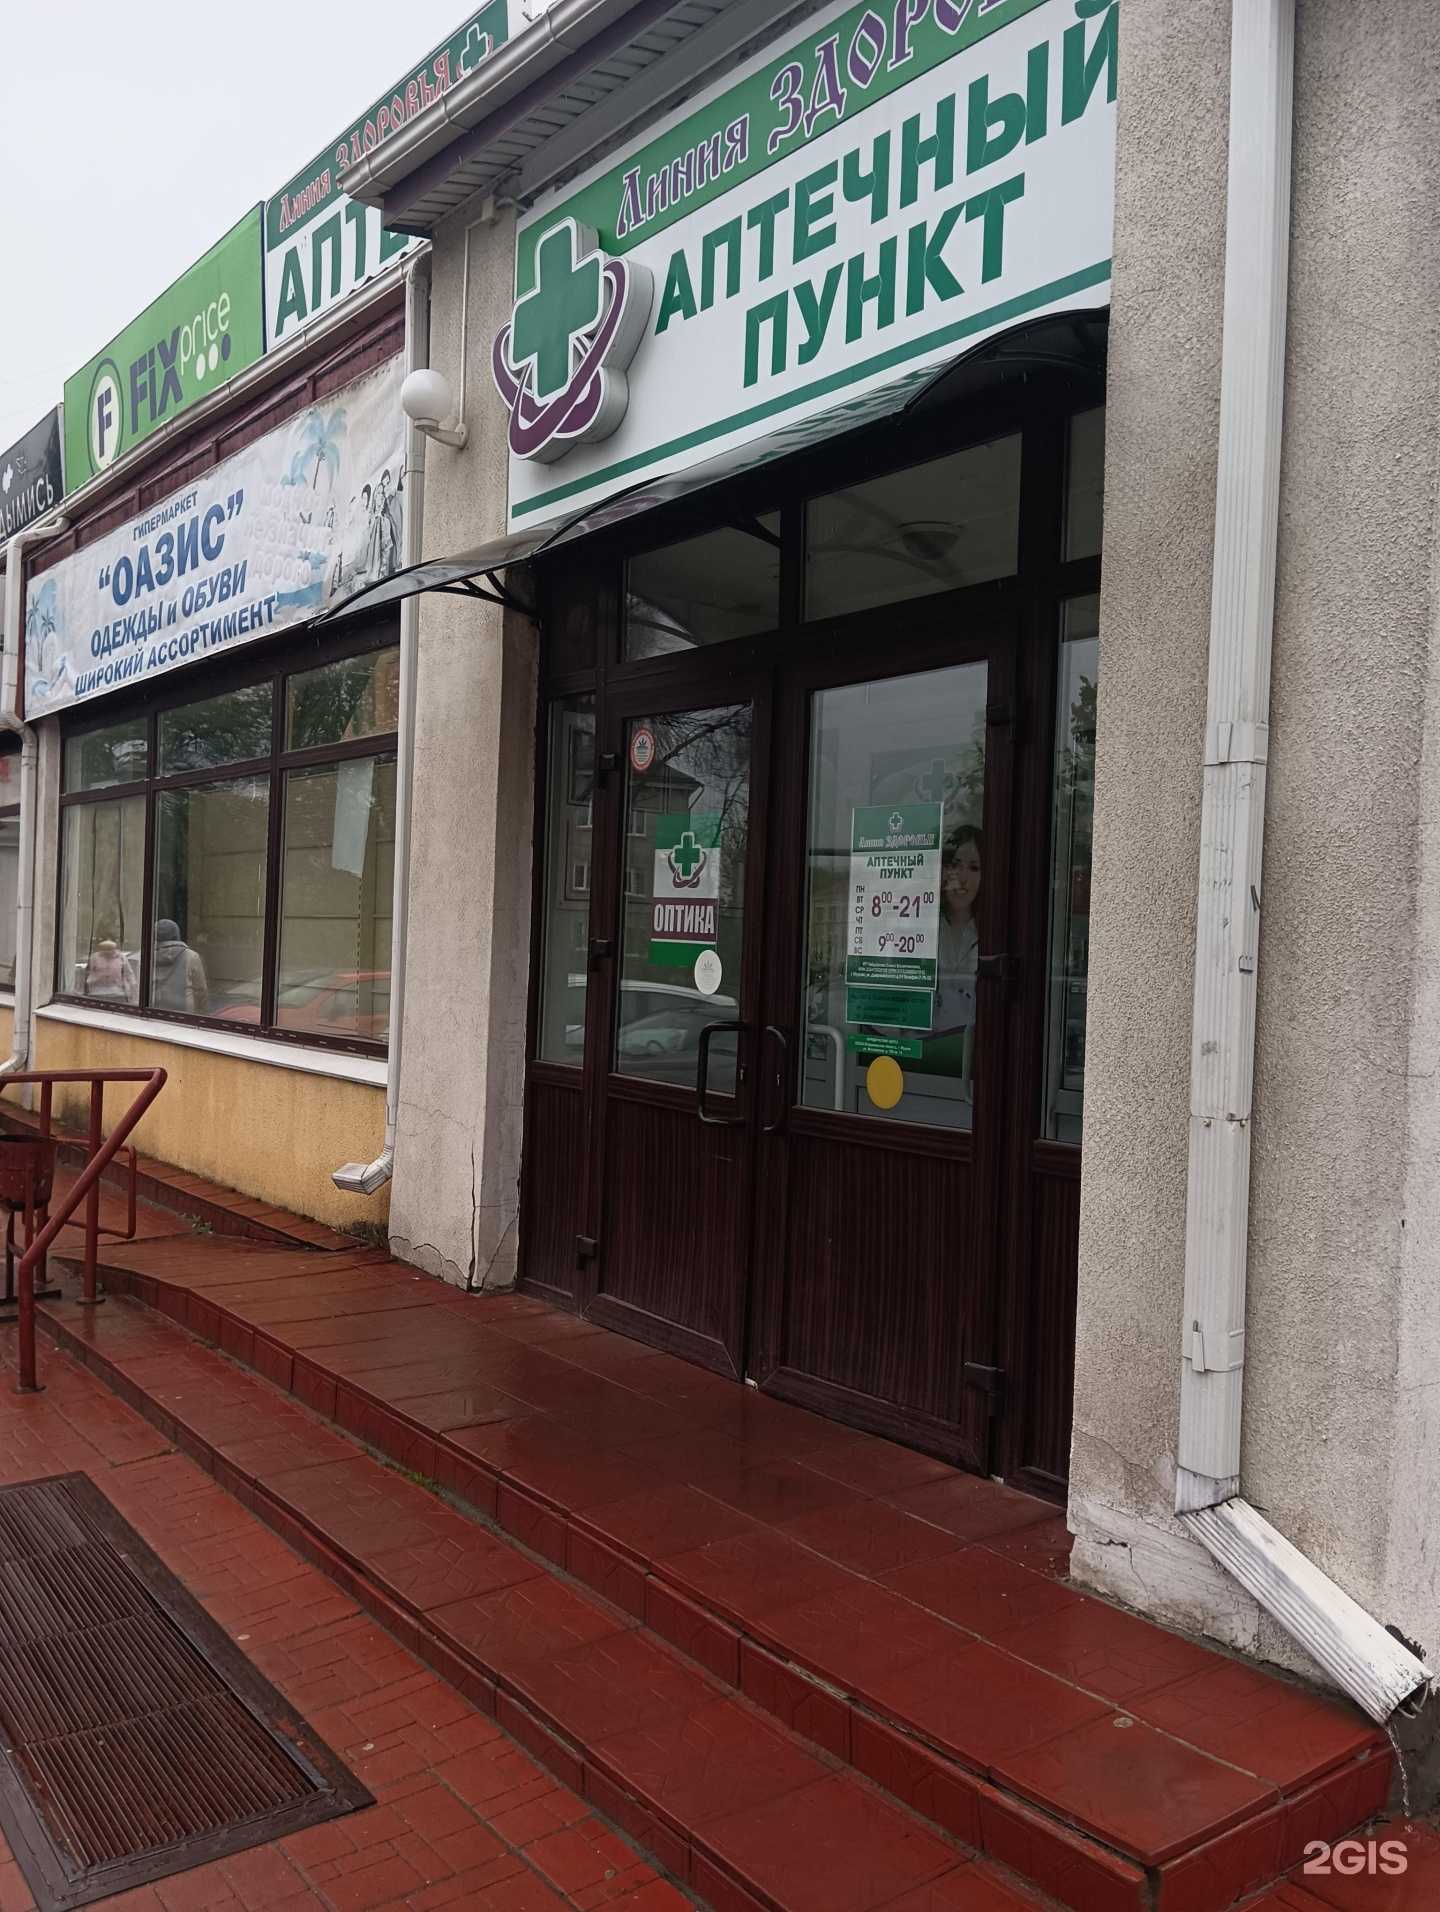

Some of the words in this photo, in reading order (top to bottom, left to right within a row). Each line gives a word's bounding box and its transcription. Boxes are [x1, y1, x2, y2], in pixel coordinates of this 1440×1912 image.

[616, 114, 749, 238] Линия
[768, 0, 1007, 153] ЗДОР
[654, 0, 1119, 336] АПТЕЧНЫЙ
[279, 168, 330, 232] Линия
[743, 172, 1025, 388] ПУНКТ
[99, 488, 244, 606] “ОАЗИС”
[133, 490, 198, 541] ГИПЕРМАРКЕТ
[75, 648, 144, 696] ШИРОКИЙ
[147, 595, 275, 669] АССОРТИМЕНТ
[90, 600, 163, 659] ОДЕЖДЫ
[182, 560, 248, 618] ОБУВИ
[867, 853, 924, 867] АПТЕЧНЫЙ
[880, 868, 914, 879] ПУНКТ
[654, 904, 714, 934] ОПТИКА
